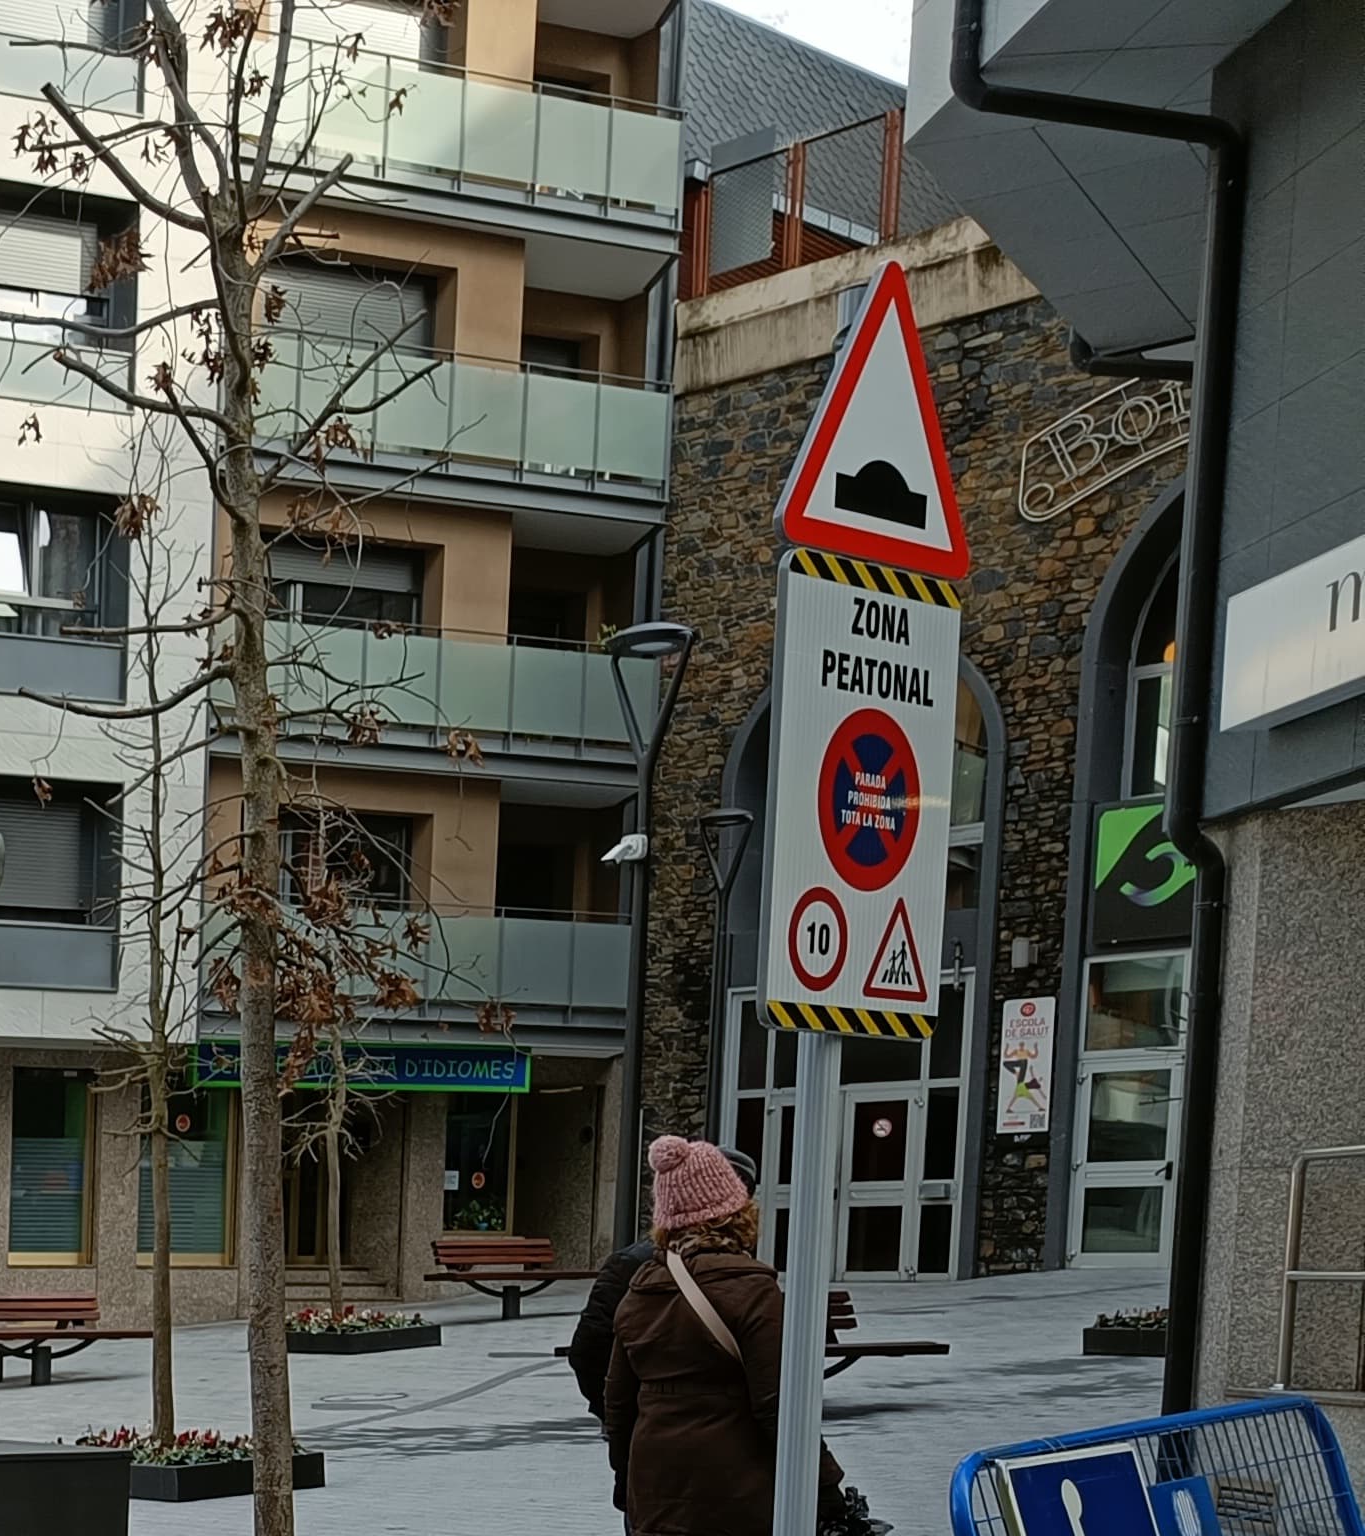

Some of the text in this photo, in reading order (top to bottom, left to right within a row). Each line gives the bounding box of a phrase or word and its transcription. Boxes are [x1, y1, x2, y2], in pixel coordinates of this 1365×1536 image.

[851, 596, 910, 646] ZONA
[821, 648, 934, 707] PEATONAL
[854, 771, 886, 790] PARADA
[847, 790, 891, 810] PROHIBIDA
[841, 809, 896, 831] TOTA LA ZONA
[806, 921, 830, 955] 10
[1005, 1025, 1050, 1038] DE SALUT
[1010, 1017, 1046, 1028] ESCOLA
[405, 1057, 516, 1080] D'IDIOMES
